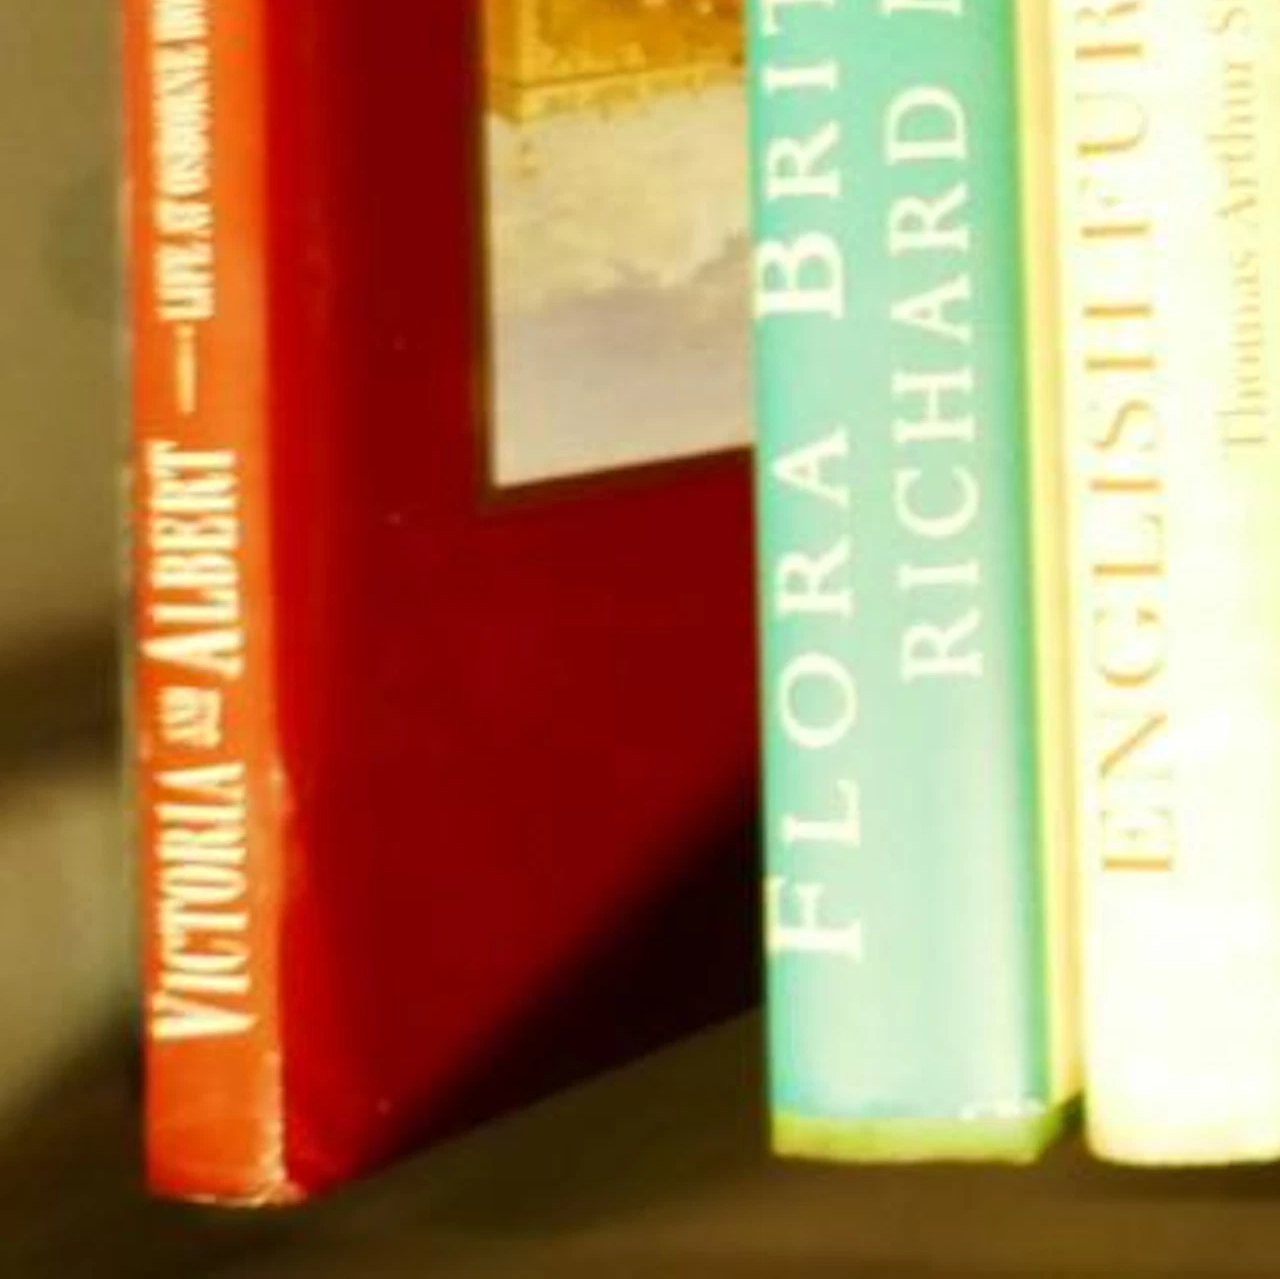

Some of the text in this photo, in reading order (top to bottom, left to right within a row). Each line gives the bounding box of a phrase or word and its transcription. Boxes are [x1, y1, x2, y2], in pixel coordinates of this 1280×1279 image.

[140, 440, 246, 680] ALBERT
[884, 85, 984, 682] RICHARD
[1083, 302, 1176, 874] ENGLISH
[147, 762, 258, 1040] VICTORIA
[763, 425, 864, 964] FLORA
